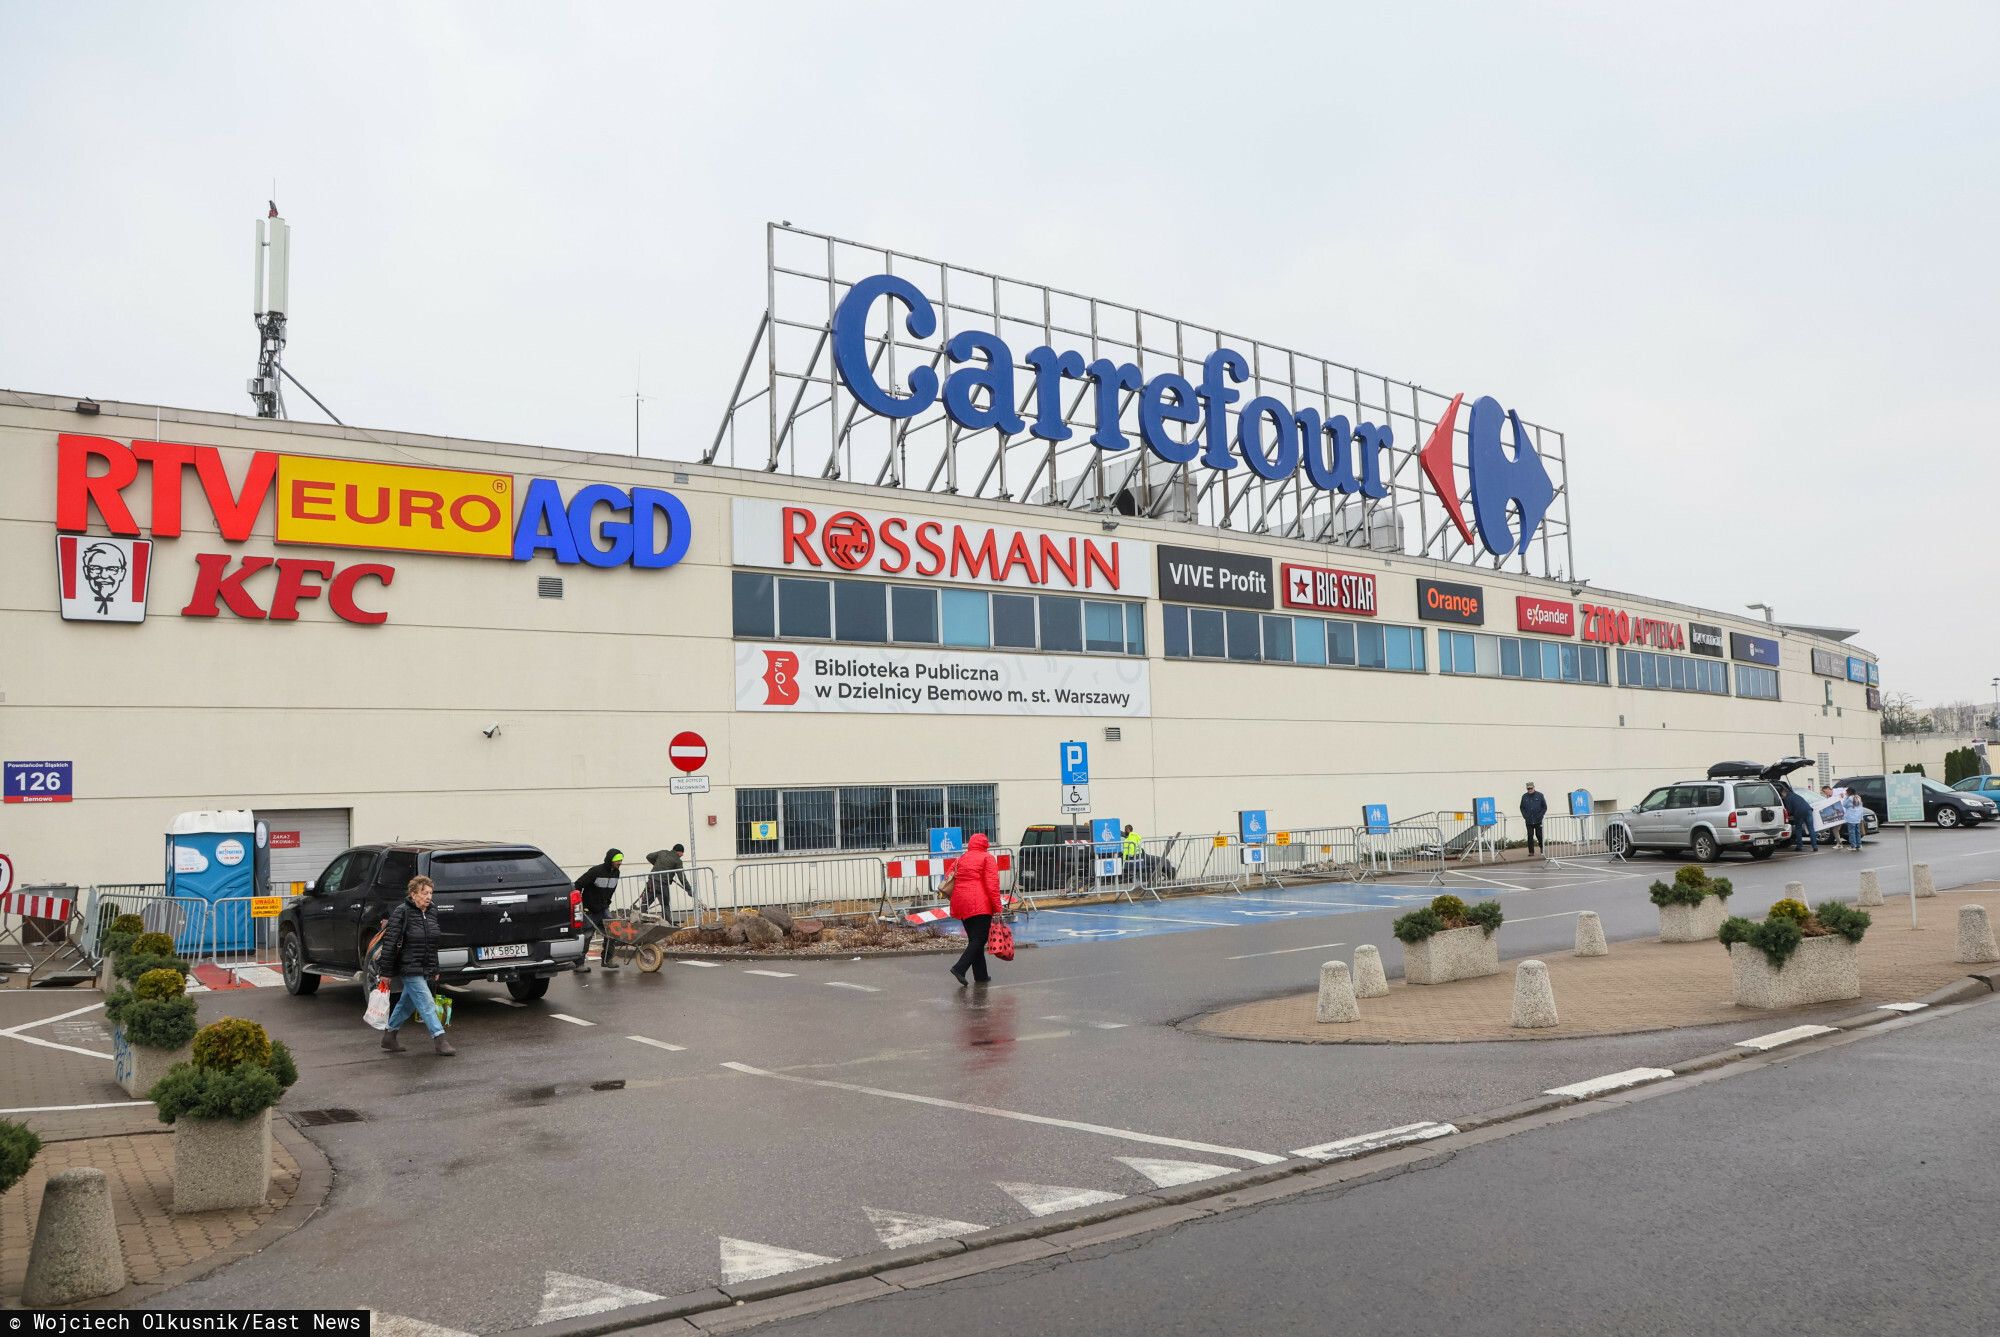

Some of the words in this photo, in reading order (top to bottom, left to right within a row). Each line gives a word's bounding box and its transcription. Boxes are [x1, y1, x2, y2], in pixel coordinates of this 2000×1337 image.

[832, 273, 1393, 499] Carrefour
[57, 432, 278, 542] RTV
[290, 479, 501, 533] EURO
[514, 478, 691, 569] AGD
[782, 506, 1120, 590] ROSSMANN
[181, 553, 396, 624] KFC
[1169, 562, 1214, 590] VIVE
[1219, 567, 1267, 595] Profit
[1316, 570, 1339, 606] BIG
[1341, 574, 1375, 611] STAR
[1427, 587, 1478, 618] Orange
[1526, 604, 1568, 626] expander
[1632, 616, 1685, 650] APTEKA
[814, 659, 910, 679] Biblioteka
[915, 663, 999, 682] Publiczna
[815, 685, 832, 699] w
[838, 682, 922, 704] Dzielnicy
[927, 686, 1003, 703] Bemowo
[1007, 690, 1028, 703] m.
[1031, 689, 1050, 704] st.
[1054, 689, 1130, 708] Warszawy
[1066, 745, 1083, 772] P
[15, 771, 61, 791] 126
[483, 946, 496, 957] WX
